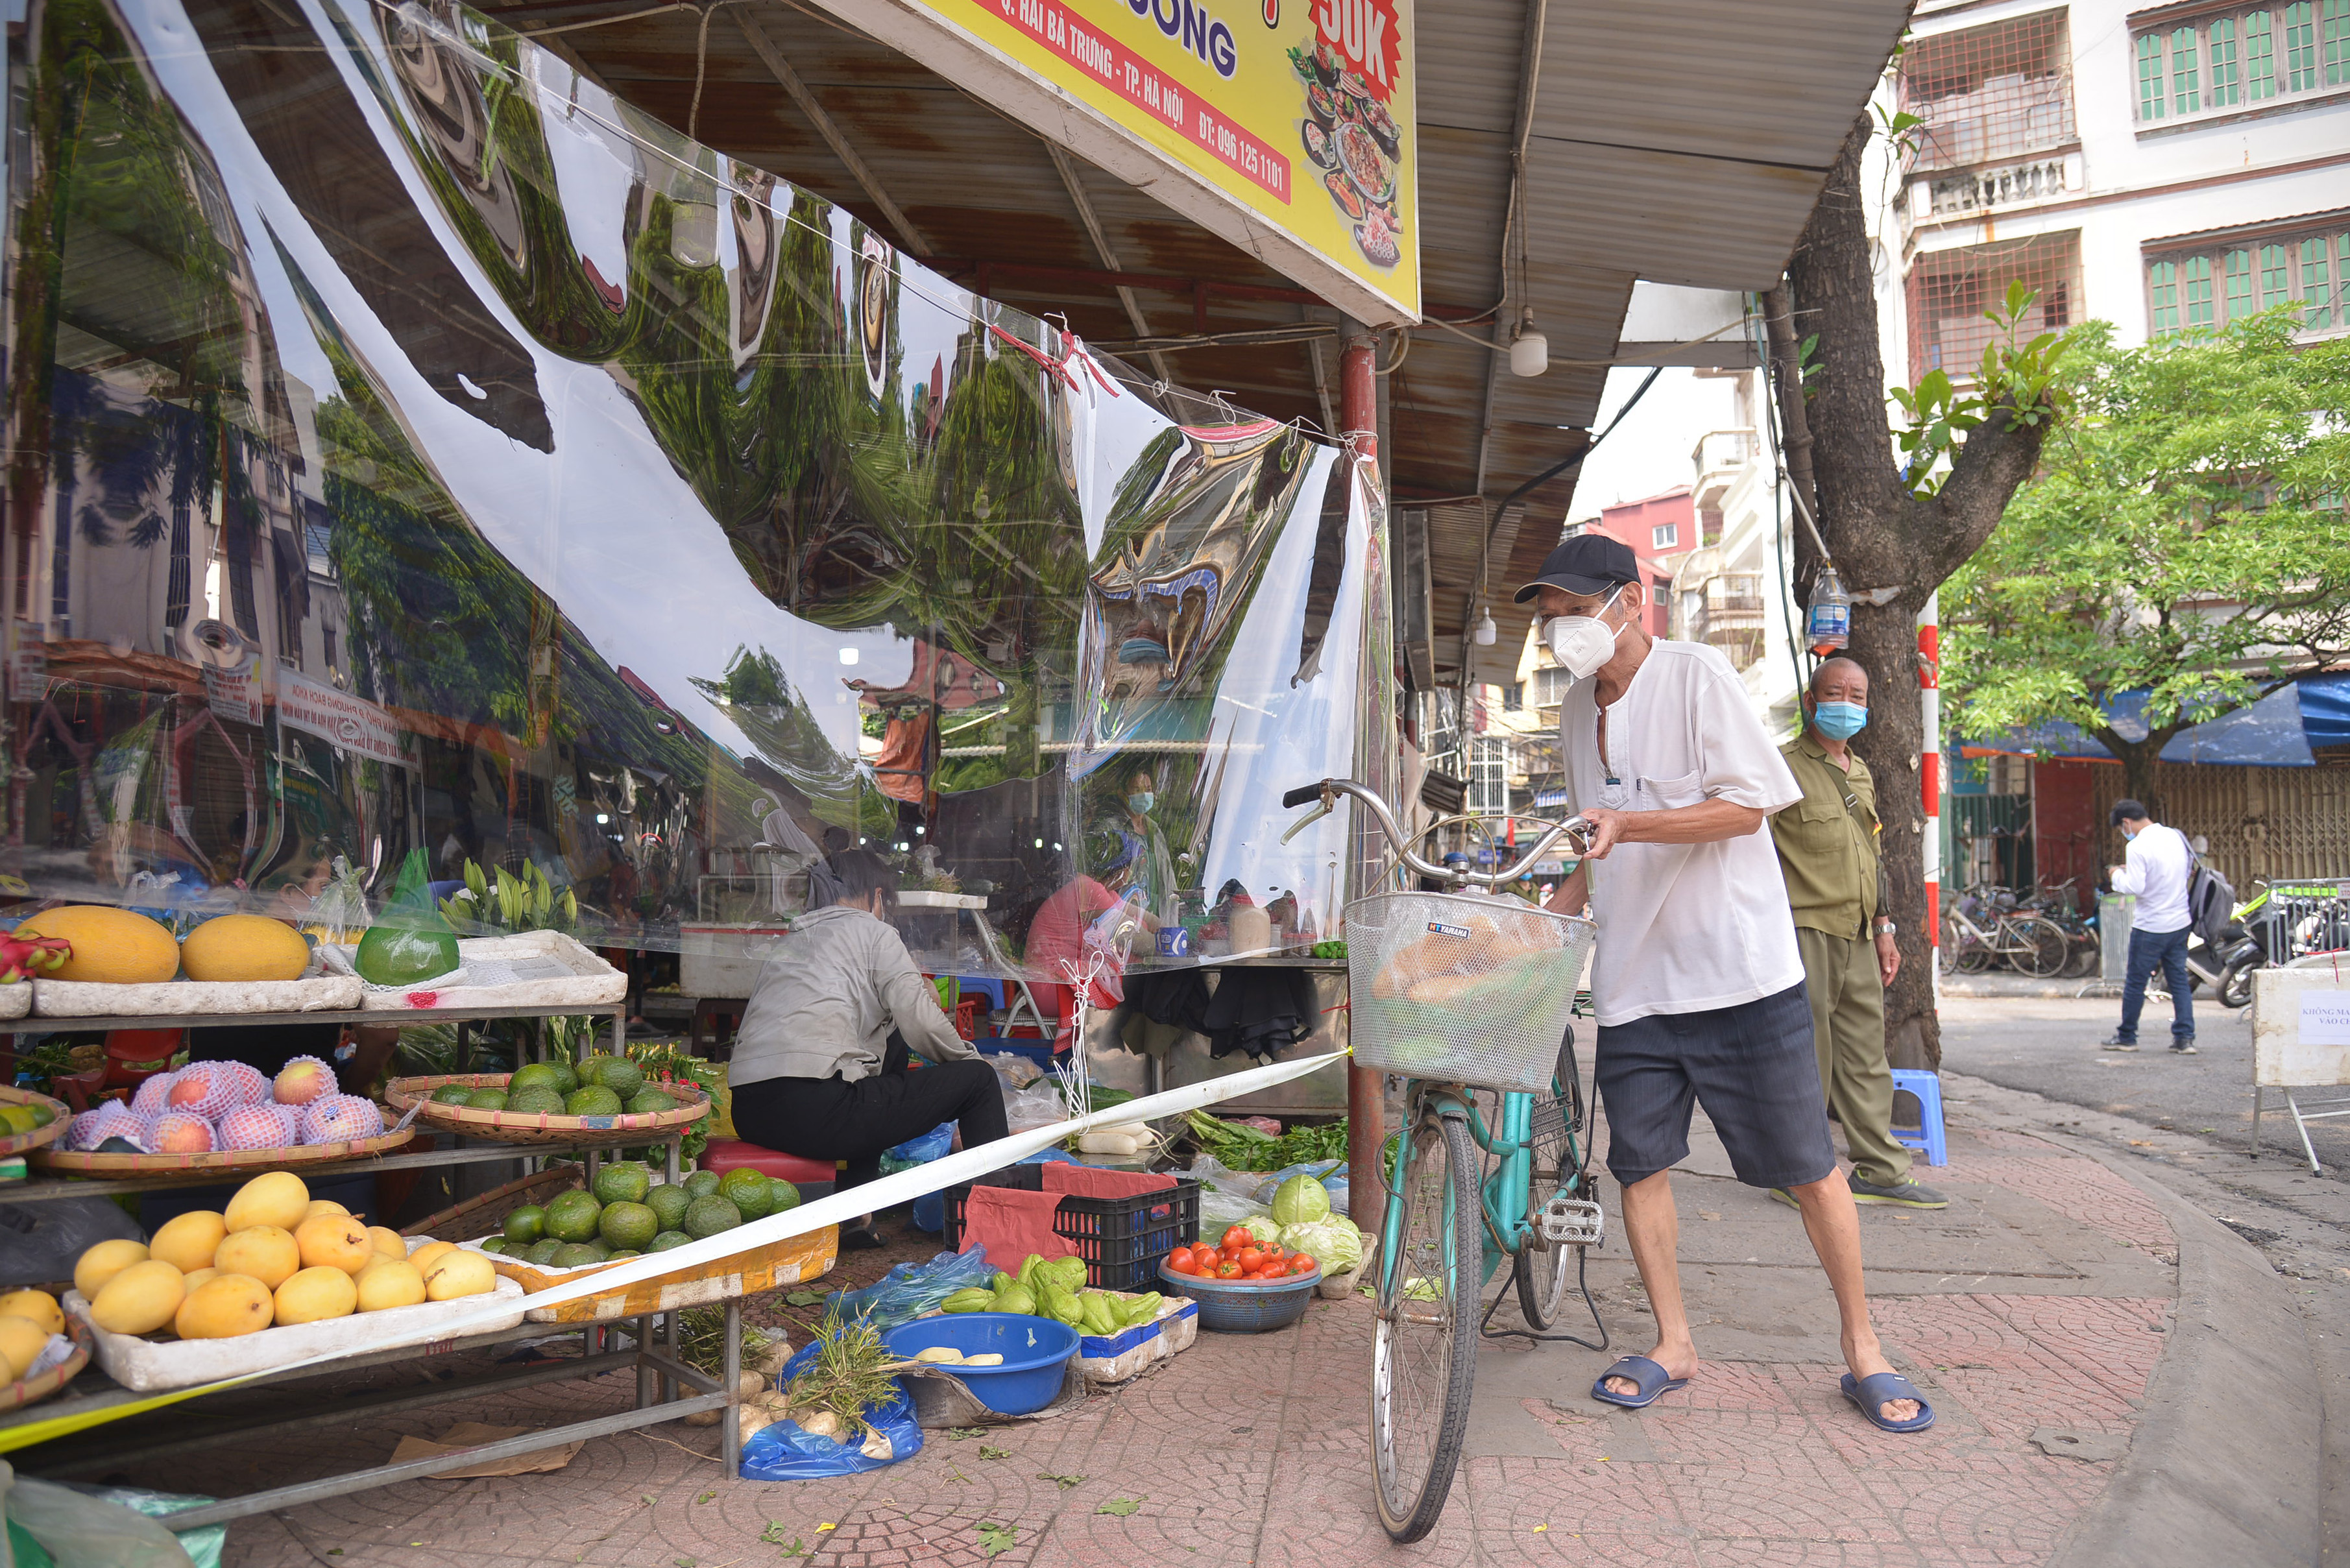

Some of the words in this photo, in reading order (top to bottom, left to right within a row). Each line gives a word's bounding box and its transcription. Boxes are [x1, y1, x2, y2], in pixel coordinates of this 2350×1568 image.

[1019, 0, 1043, 34] HAI
[1047, 9, 1065, 49] BÀ
[1070, 23, 1113, 80] TRƯNG
[1116, 67, 1121, 77] -
[1124, 60, 1141, 97] TP.
[1144, 74, 1160, 111] HÀ
[1163, 87, 1184, 128] NỘI
[1199, 111, 1215, 147] ĐT:
[1218, 125, 1237, 161] 096
[1240, 140, 1257, 175] 125
[1261, 154, 1282, 191] 1101
[2303, 1006, 2334, 1015] KHÔNG
[2320, 1016, 2338, 1024] VÀO
